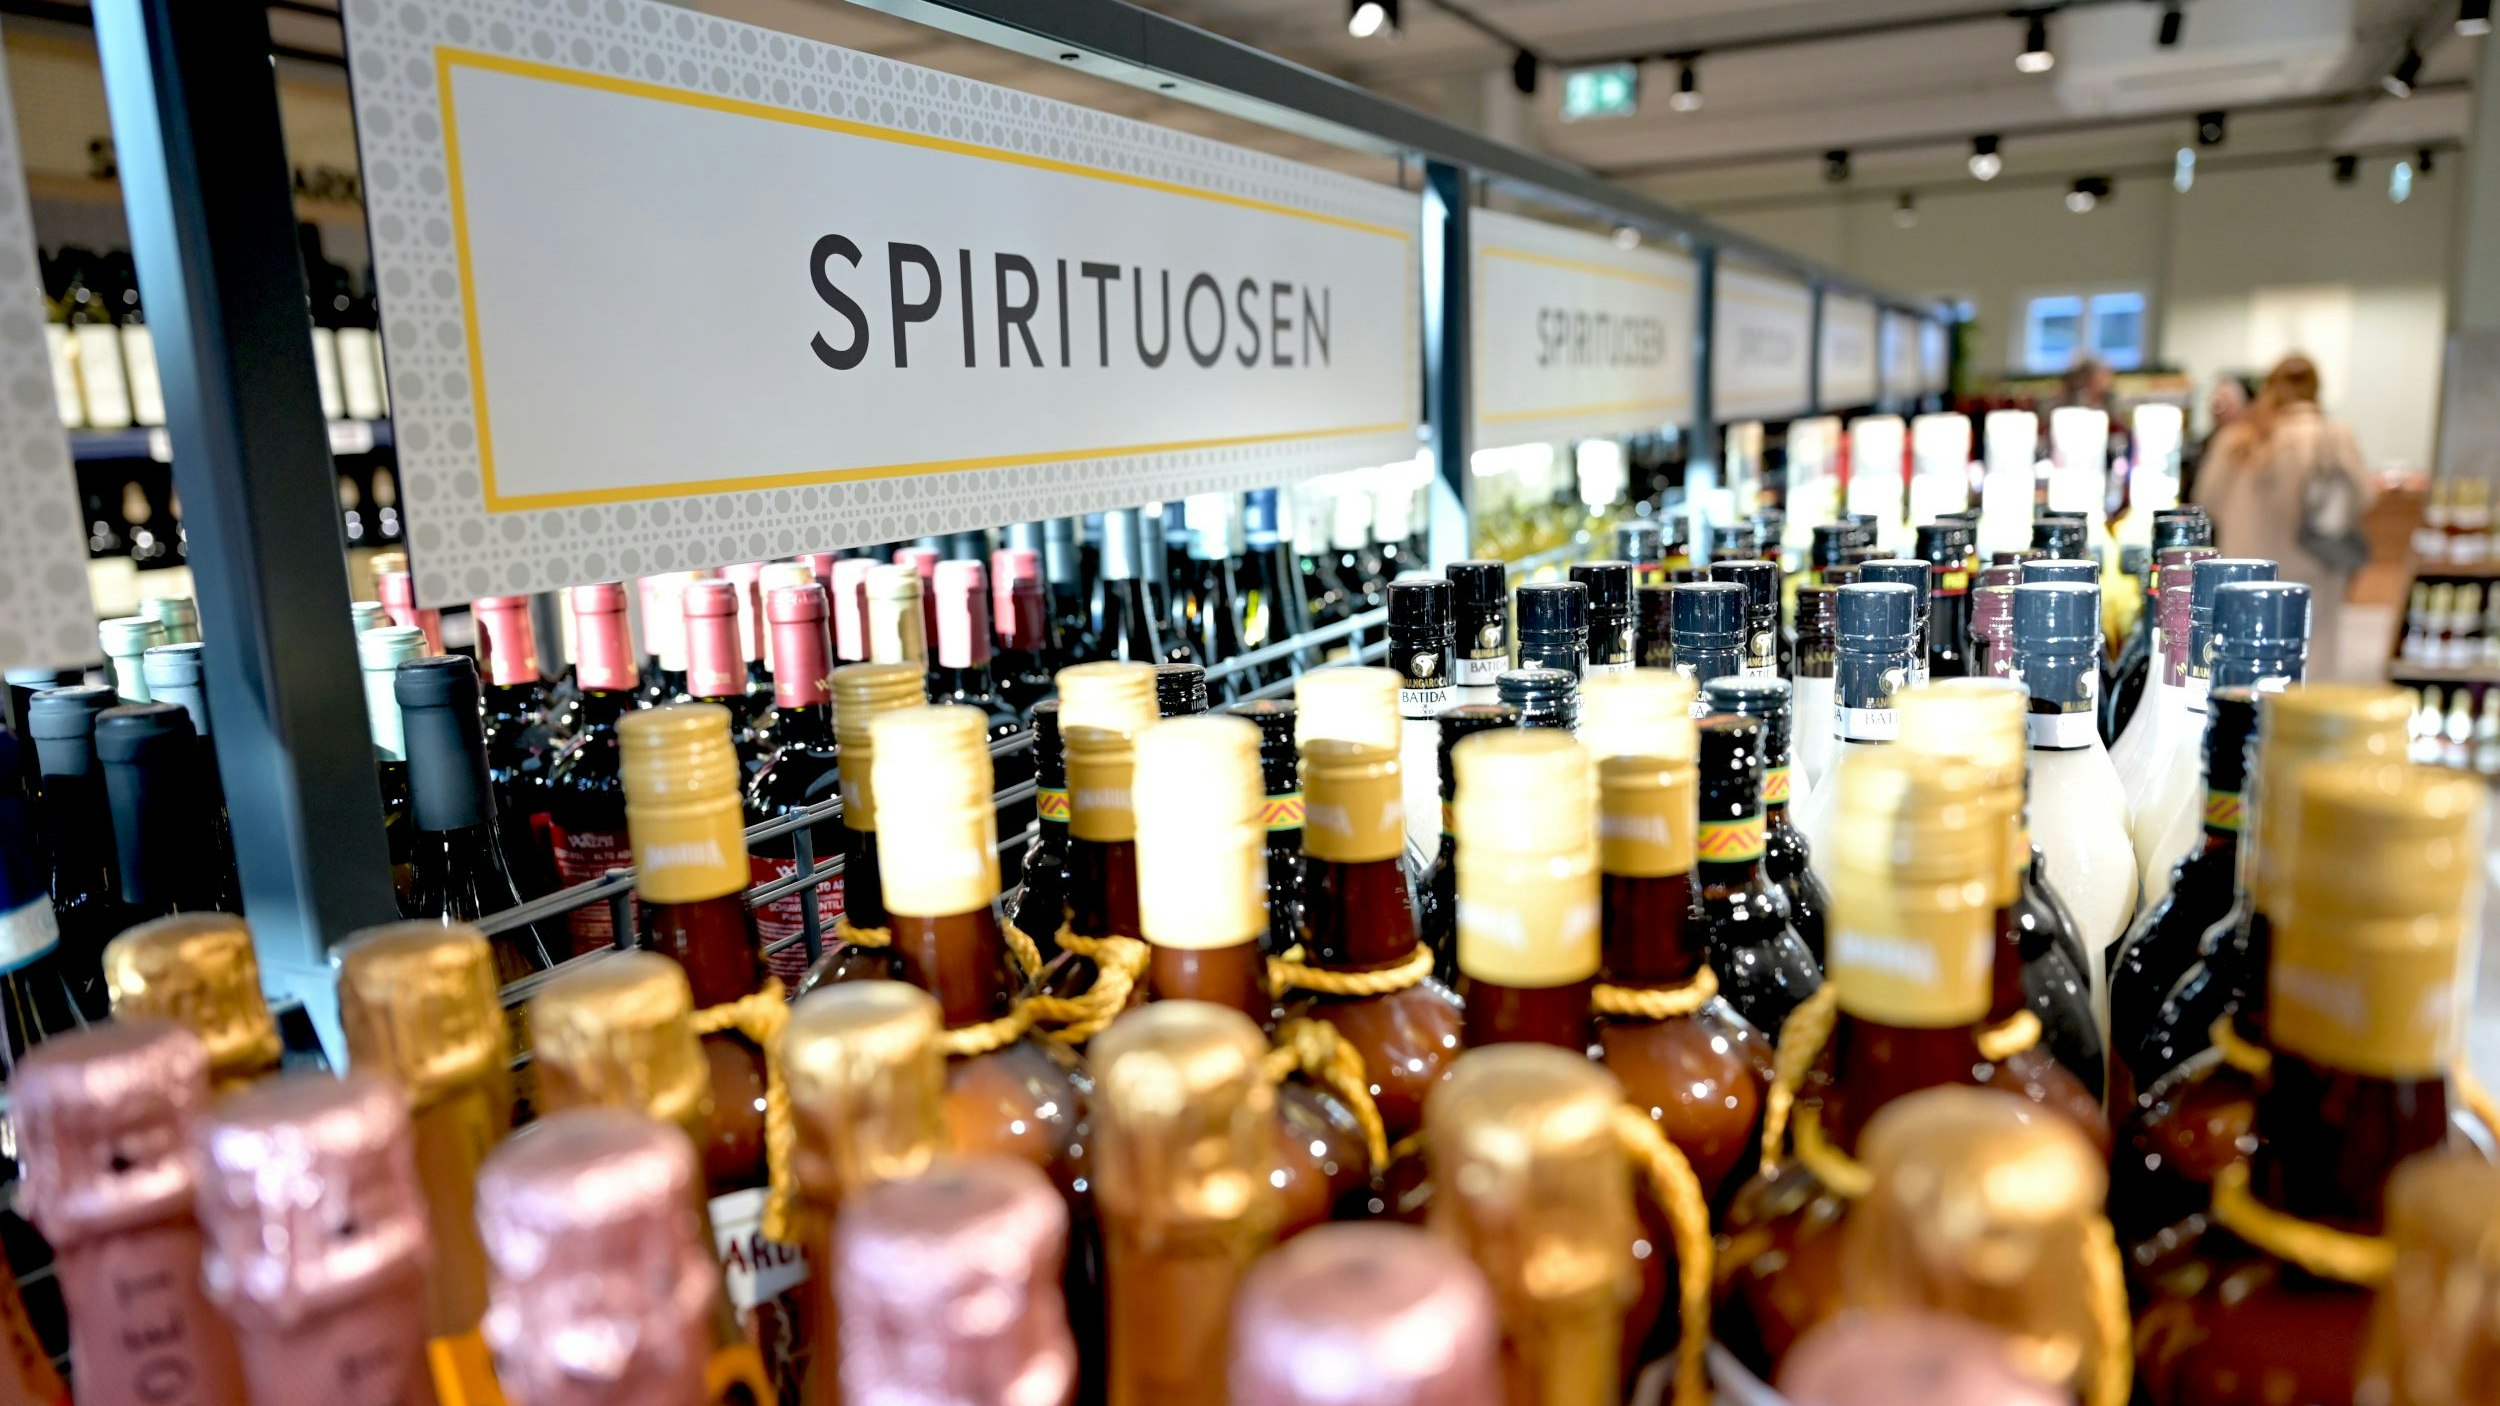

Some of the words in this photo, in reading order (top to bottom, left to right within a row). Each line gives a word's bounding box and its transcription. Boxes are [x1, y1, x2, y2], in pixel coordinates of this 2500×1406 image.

[810, 233, 1331, 370] SPIRITUOSEN
[1402, 690, 1447, 703] BATIDA
[768, 901, 801, 913] SCHIAV
[113, 1267, 197, 1406] OET
